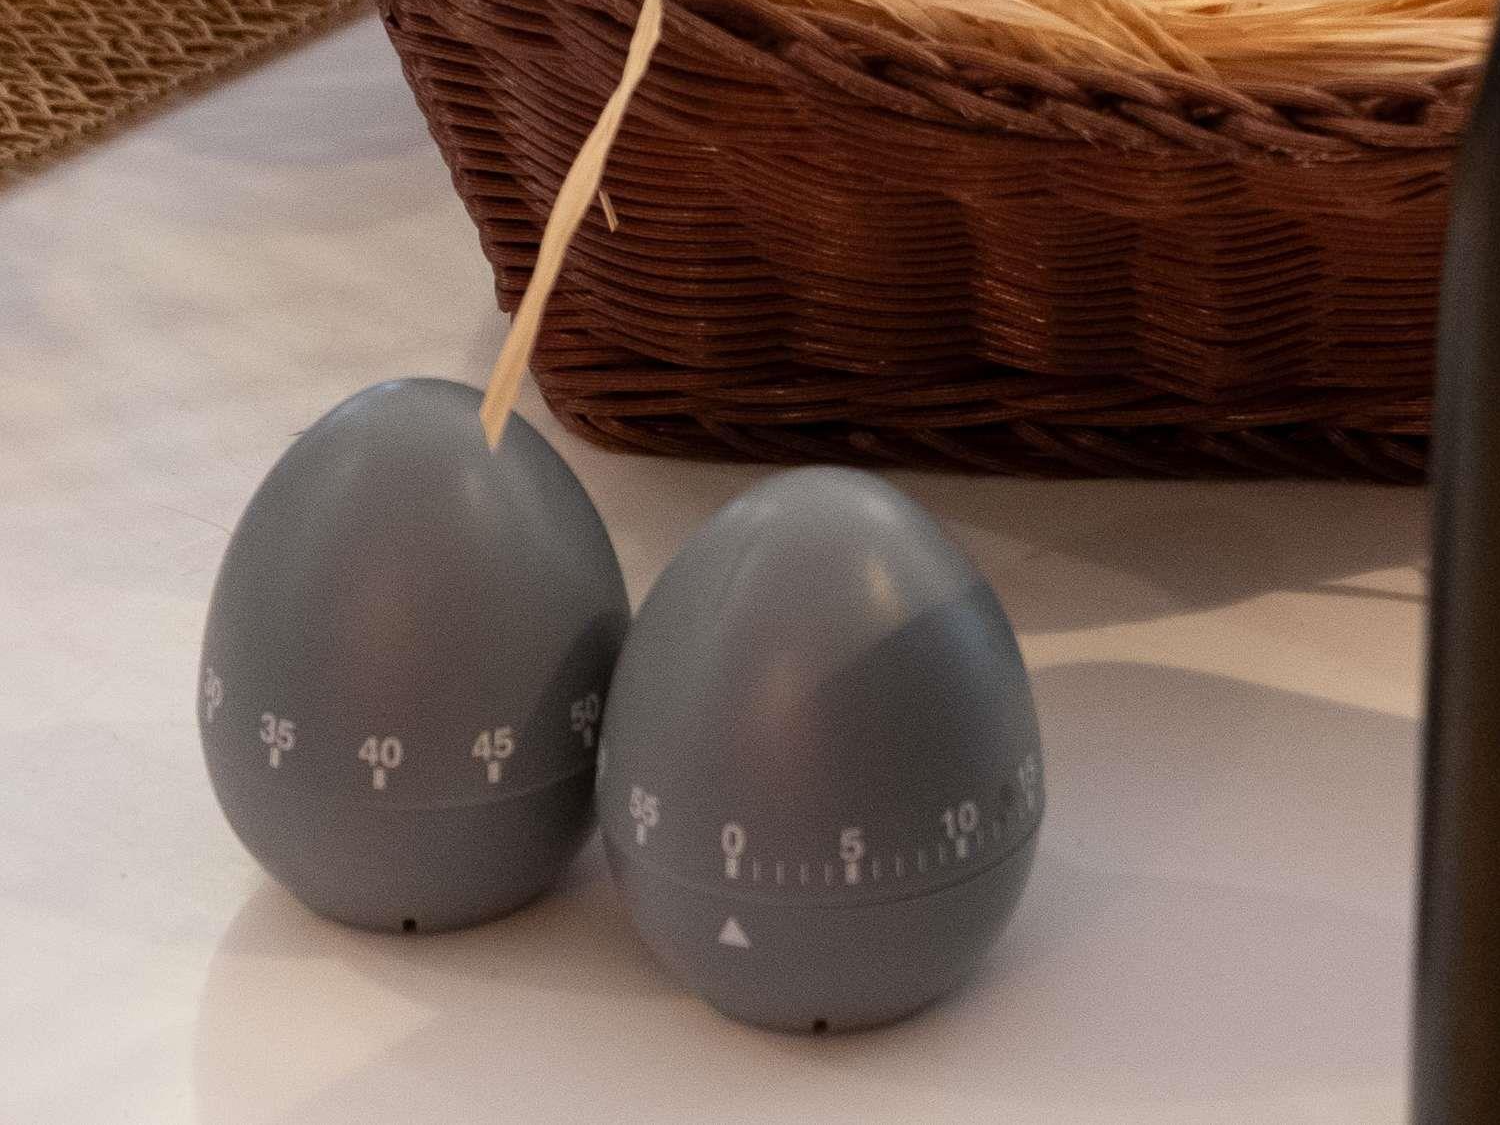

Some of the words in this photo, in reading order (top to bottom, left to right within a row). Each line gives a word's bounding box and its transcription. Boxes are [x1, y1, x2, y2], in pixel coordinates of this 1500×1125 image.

[259, 712, 296, 751] 35
[358, 736, 403, 768] 40
[471, 726, 514, 760] 45
[720, 821, 746, 857] 0
[839, 827, 865, 862] 5
[942, 800, 978, 841] 10
